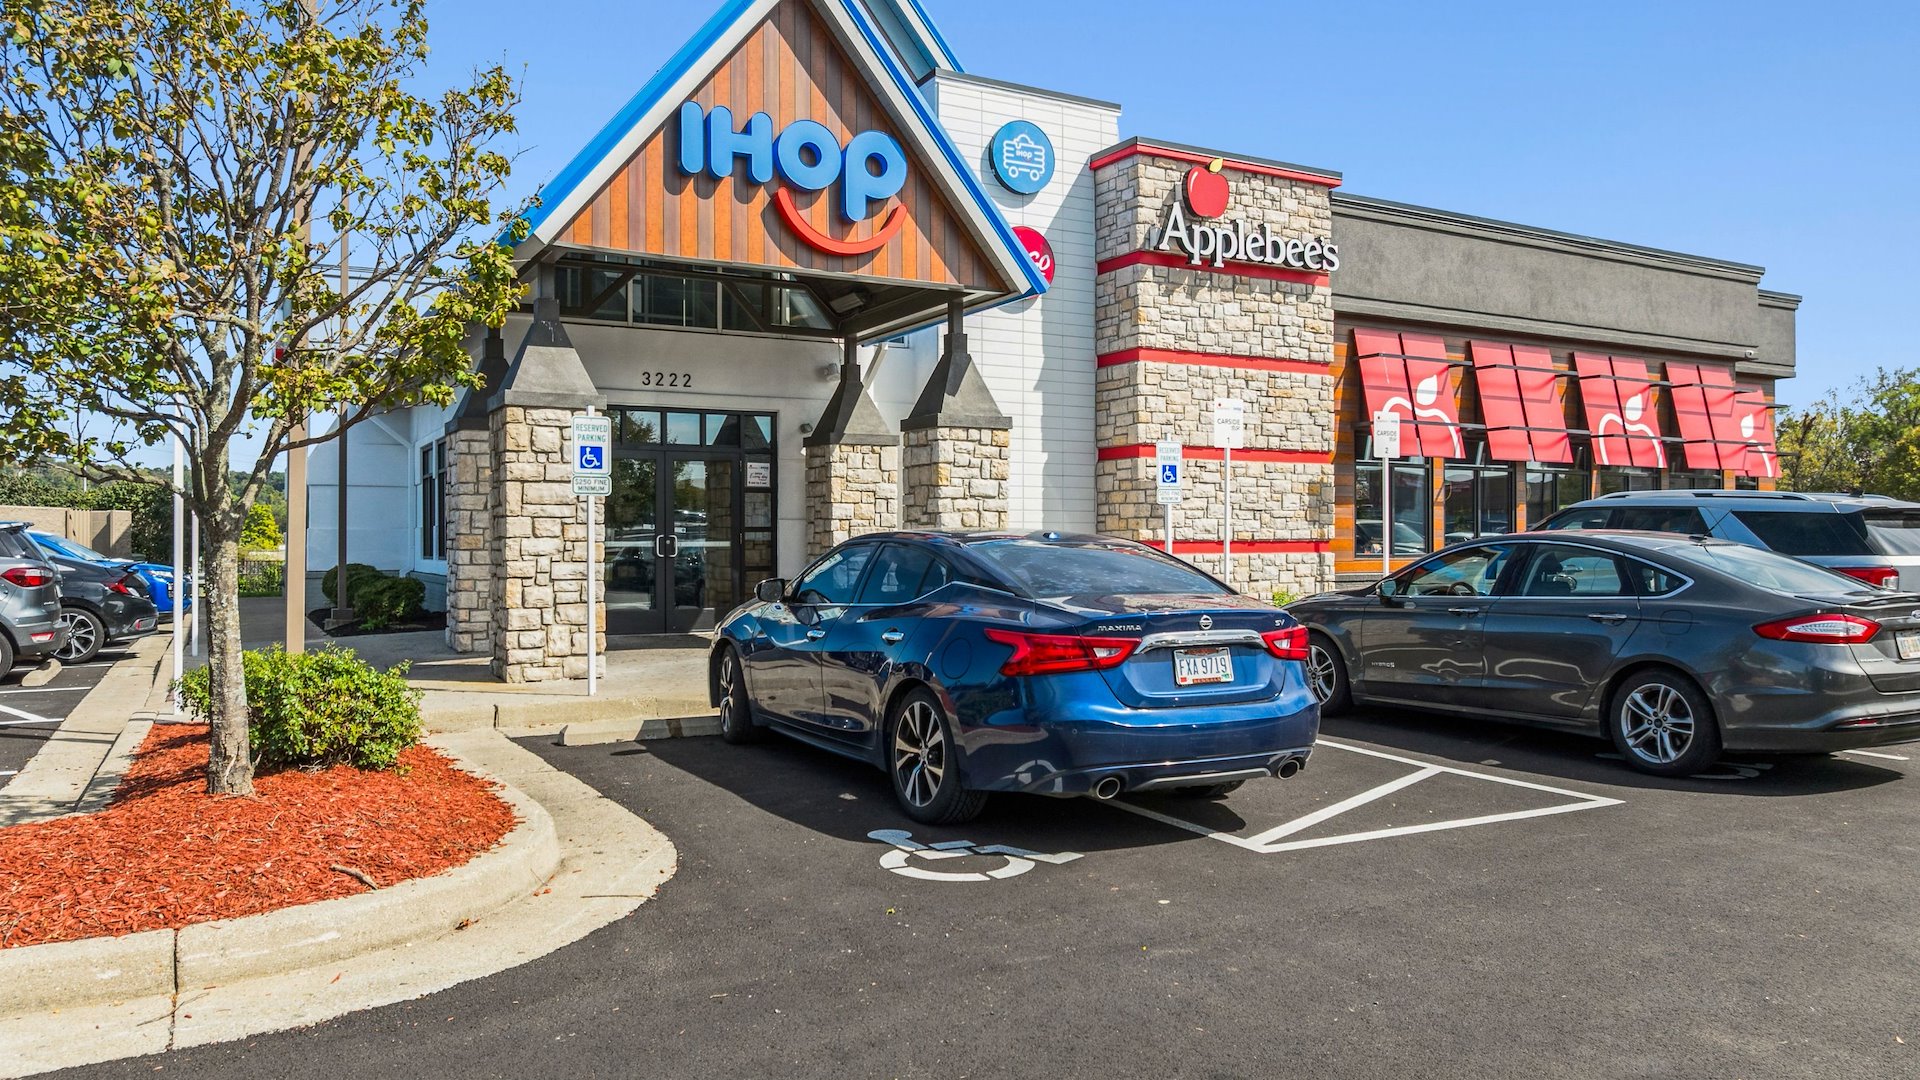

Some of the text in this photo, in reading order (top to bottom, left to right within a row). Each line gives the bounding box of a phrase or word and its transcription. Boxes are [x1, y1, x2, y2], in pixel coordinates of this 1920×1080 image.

[1158, 201, 1340, 272] Applebee's
[641, 371, 692, 388] 3222
[575, 423, 608, 433] RESERVED
[577, 433, 606, 443] PARKING
[575, 478, 592, 486] $250
[1097, 624, 1143, 632] MAXIMA
[1274, 619, 1286, 627] SV
[1179, 656, 1228, 676] FXA 9719
